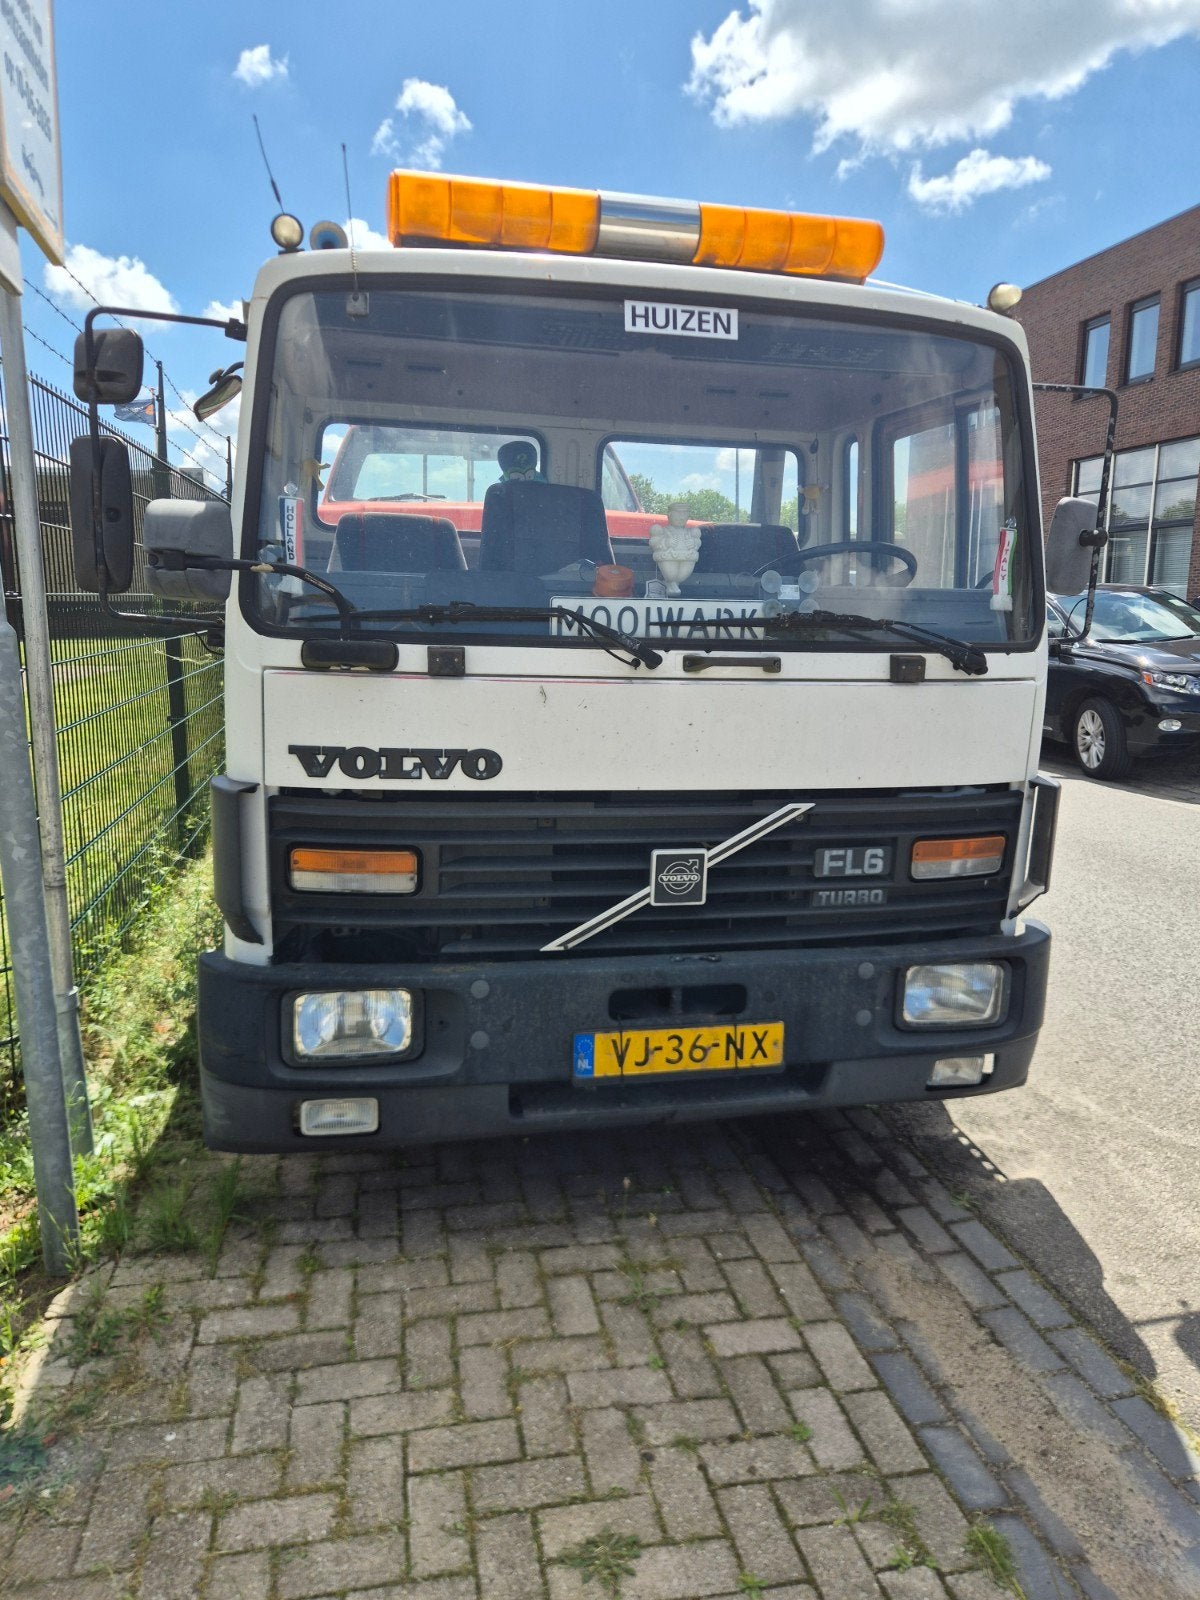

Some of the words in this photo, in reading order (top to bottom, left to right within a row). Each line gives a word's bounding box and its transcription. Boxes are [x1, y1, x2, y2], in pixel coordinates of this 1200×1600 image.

[631, 305, 731, 335] HUIZEN
[286, 506, 295, 561] HOLLAND
[1001, 541, 1010, 581] ITALY
[556, 604, 758, 640] MOOIWARK
[288, 744, 503, 781] VOLVO
[822, 848, 885, 876] FL6
[818, 889, 883, 906] TURBO
[577, 1058, 592, 1069] NL
[611, 1030, 769, 1068] VJ-36-NX
